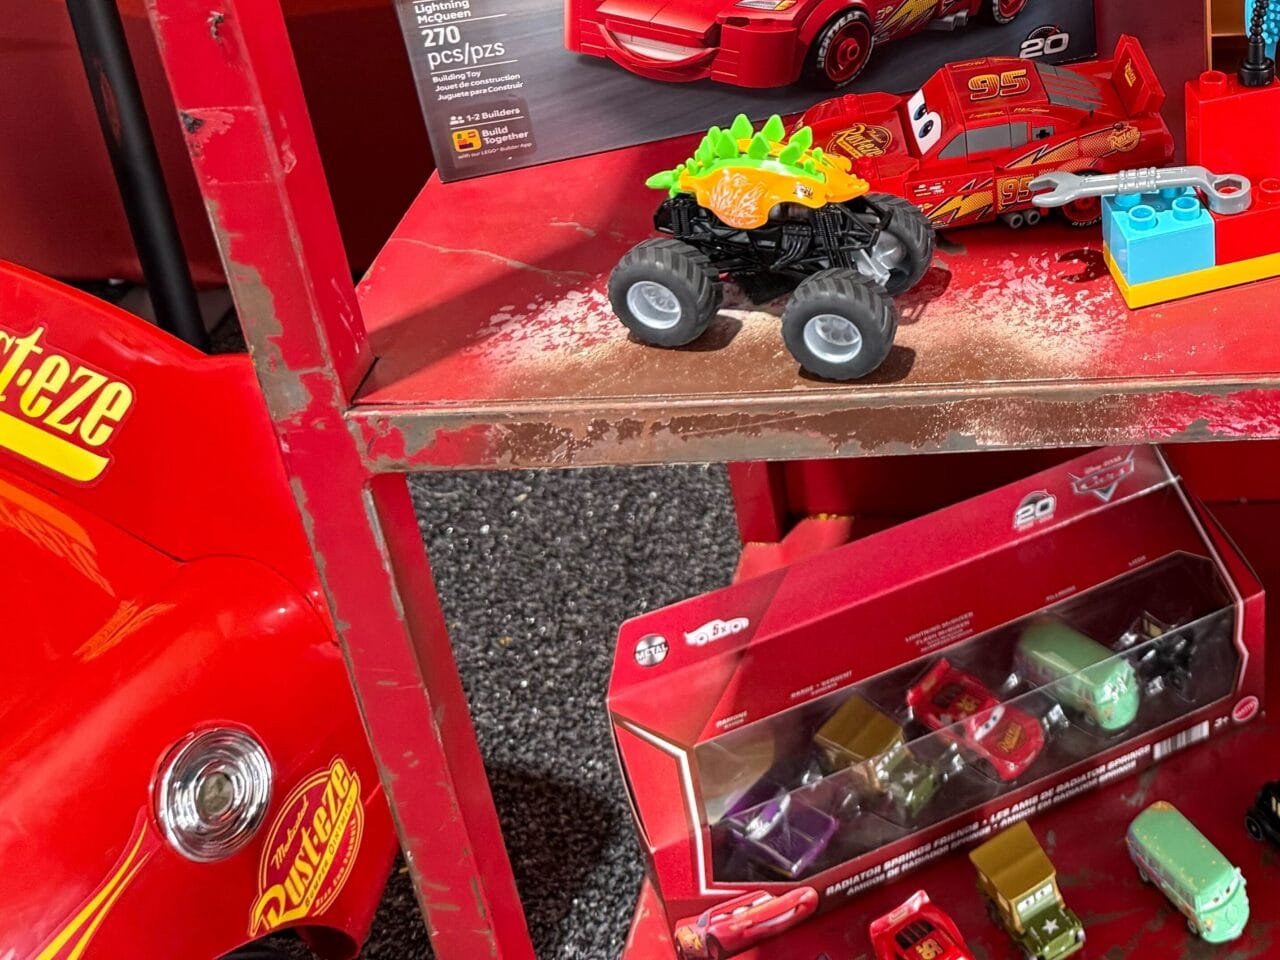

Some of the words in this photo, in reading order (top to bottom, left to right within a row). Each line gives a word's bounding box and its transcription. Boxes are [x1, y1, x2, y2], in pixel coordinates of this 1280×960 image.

[414, 0, 470, 15] Lightning
[417, 10, 472, 24] McQueen
[421, 25, 461, 47] 270
[1019, 32, 1070, 58] 20
[427, 42, 506, 70] pcs/pzs
[432, 73, 466, 83] Building
[467, 71, 481, 79] Toy
[435, 83, 458, 92] Jouet
[470, 73, 521, 86] construction
[968, 69, 1030, 101] 95
[437, 90, 469, 101] Juguete
[470, 88, 488, 97] para
[488, 81, 524, 93] Construir
[466, 114, 481, 122] 1-2
[481, 107, 520, 120] Builders
[481, 126, 509, 137] Build
[483, 131, 529, 145] Together
[1002, 176, 1034, 205] 95
[1016, 496, 1055, 527] 20
[635, 643, 669, 661] METAL
[826, 863, 882, 896] RADIATOR
[883, 842, 932, 868] SPRINGS
